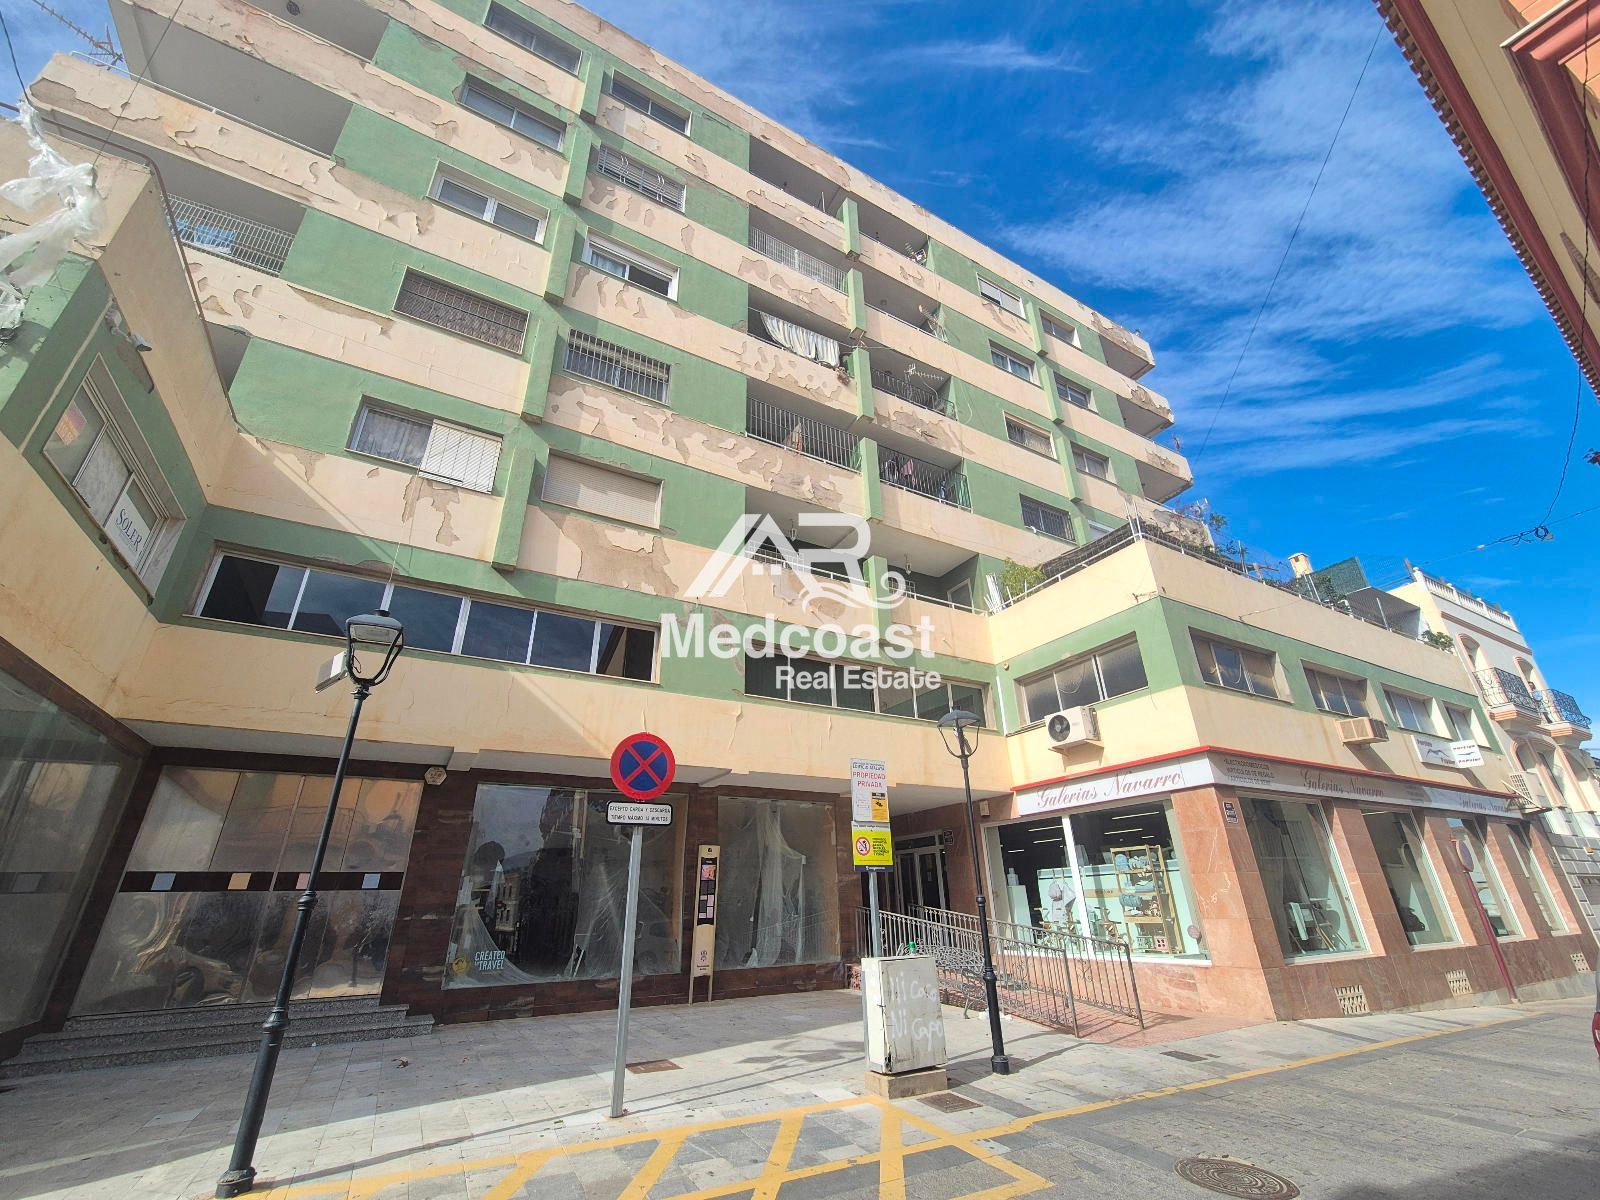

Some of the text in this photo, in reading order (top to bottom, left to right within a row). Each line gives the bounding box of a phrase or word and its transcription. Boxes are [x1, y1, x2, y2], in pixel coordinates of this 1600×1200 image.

[115, 508, 143, 552] SOLER
[853, 771, 886, 780] PROPIEDAD
[857, 780, 883, 788] PRIVADA
[1037, 770, 1181, 808] Galerias Navarro
[475, 950, 506, 960] CREATED
